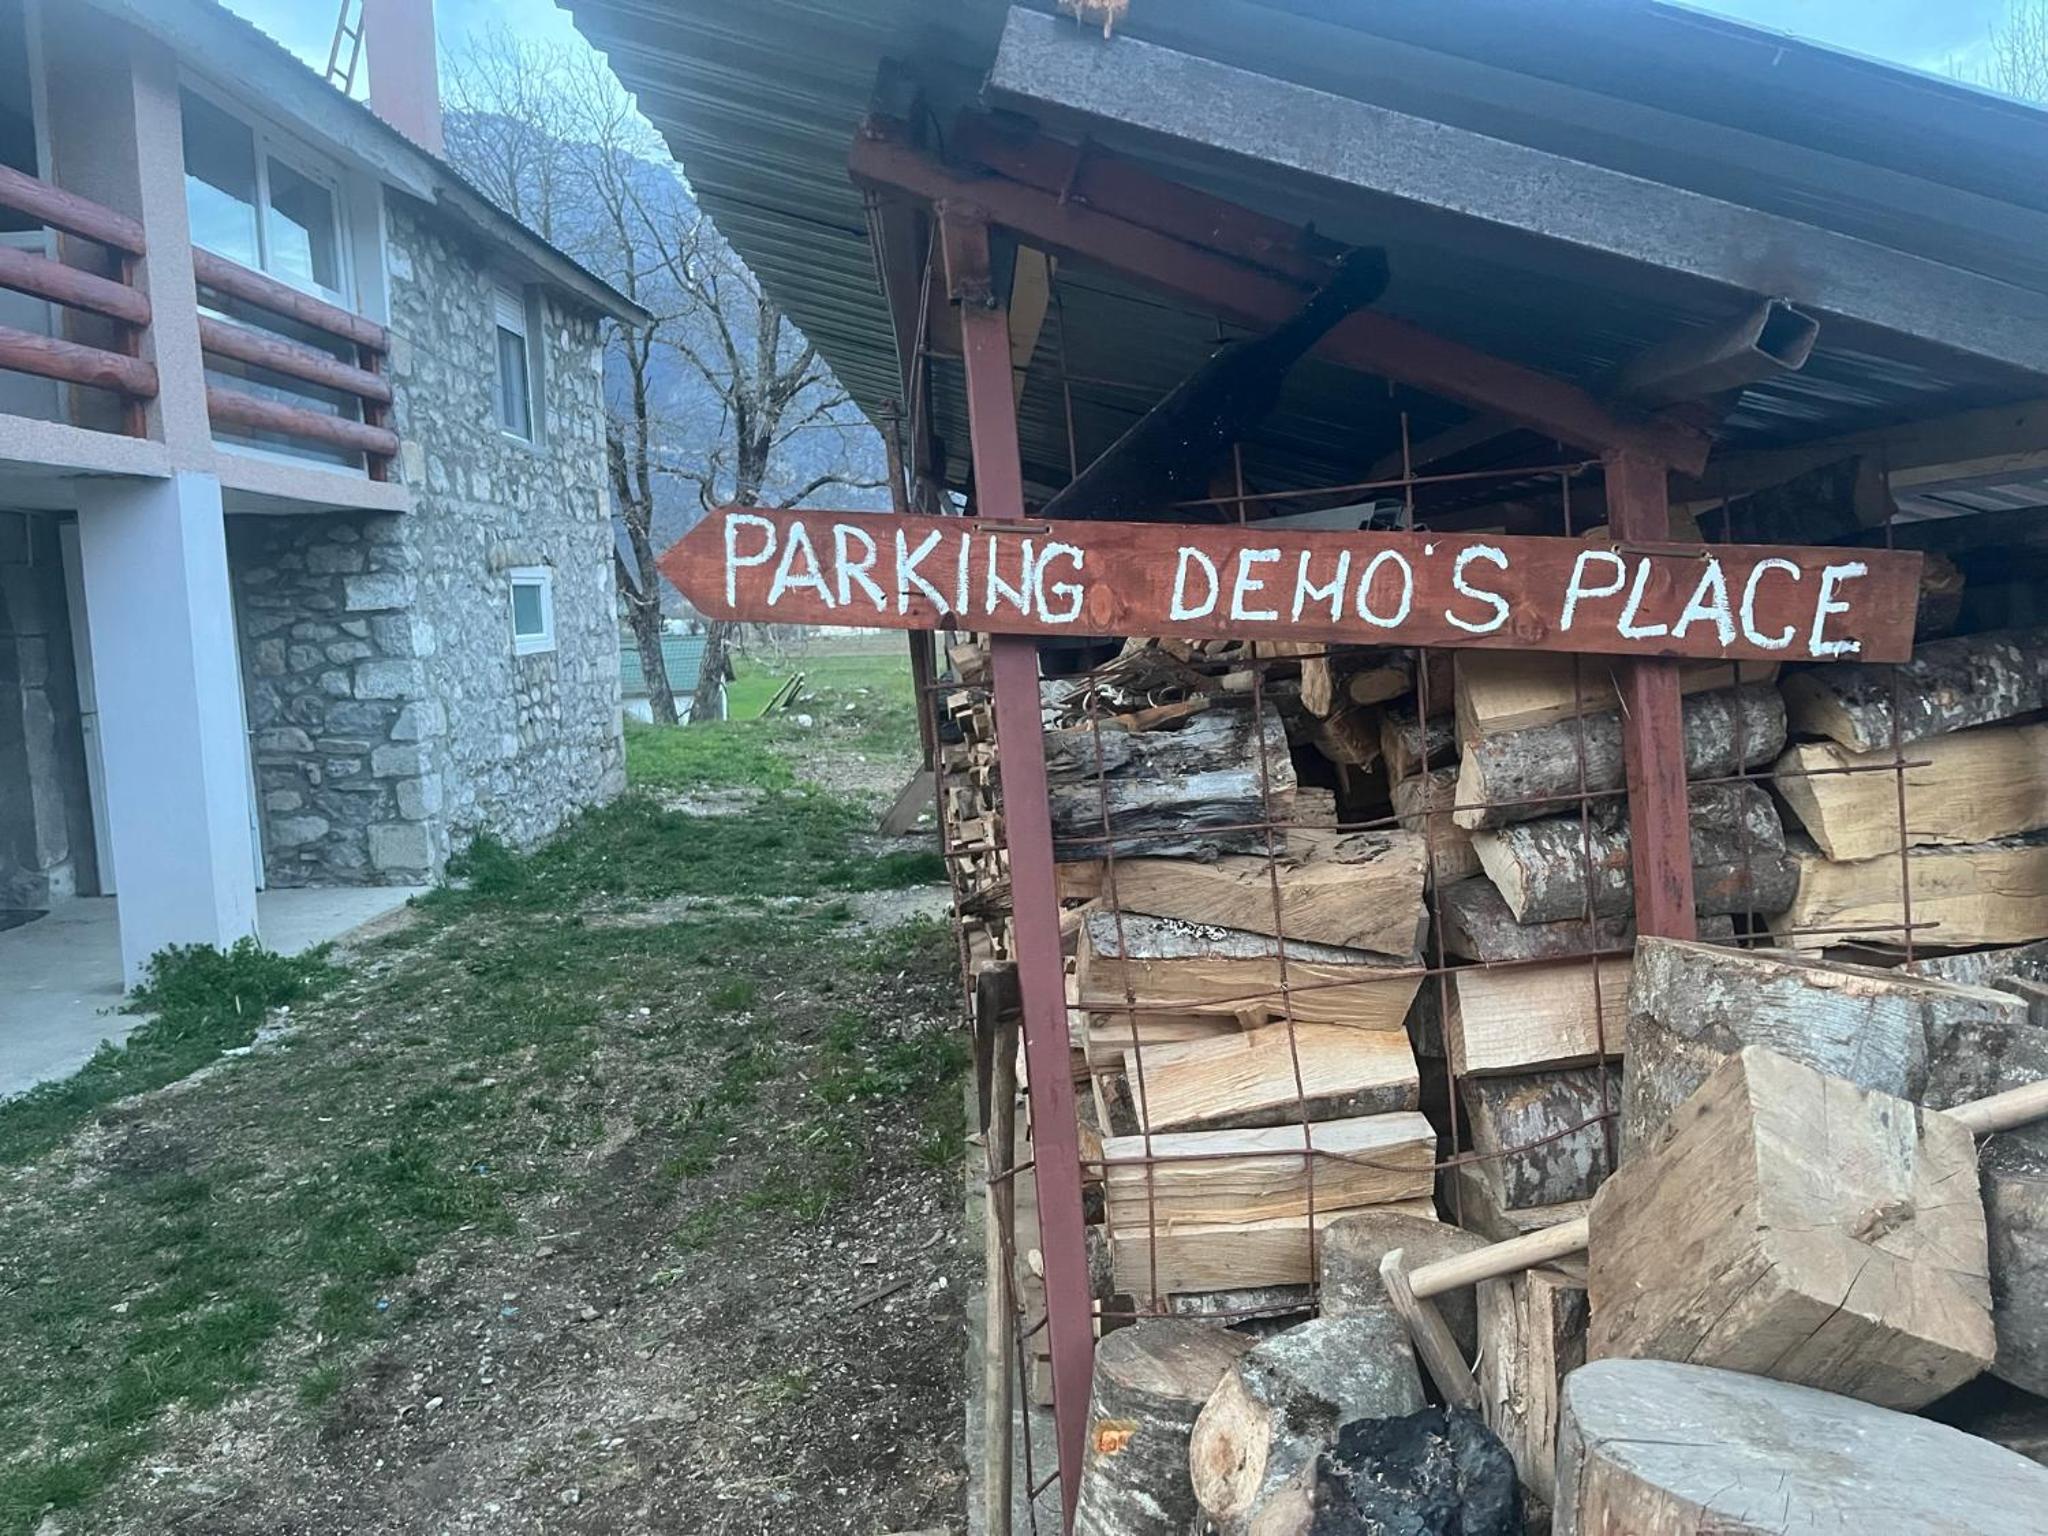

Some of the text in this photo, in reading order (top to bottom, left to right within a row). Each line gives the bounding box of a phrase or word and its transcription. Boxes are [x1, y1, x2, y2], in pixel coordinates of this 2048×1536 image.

[723, 512, 1869, 658] PARKING DEMO'S PLACE
